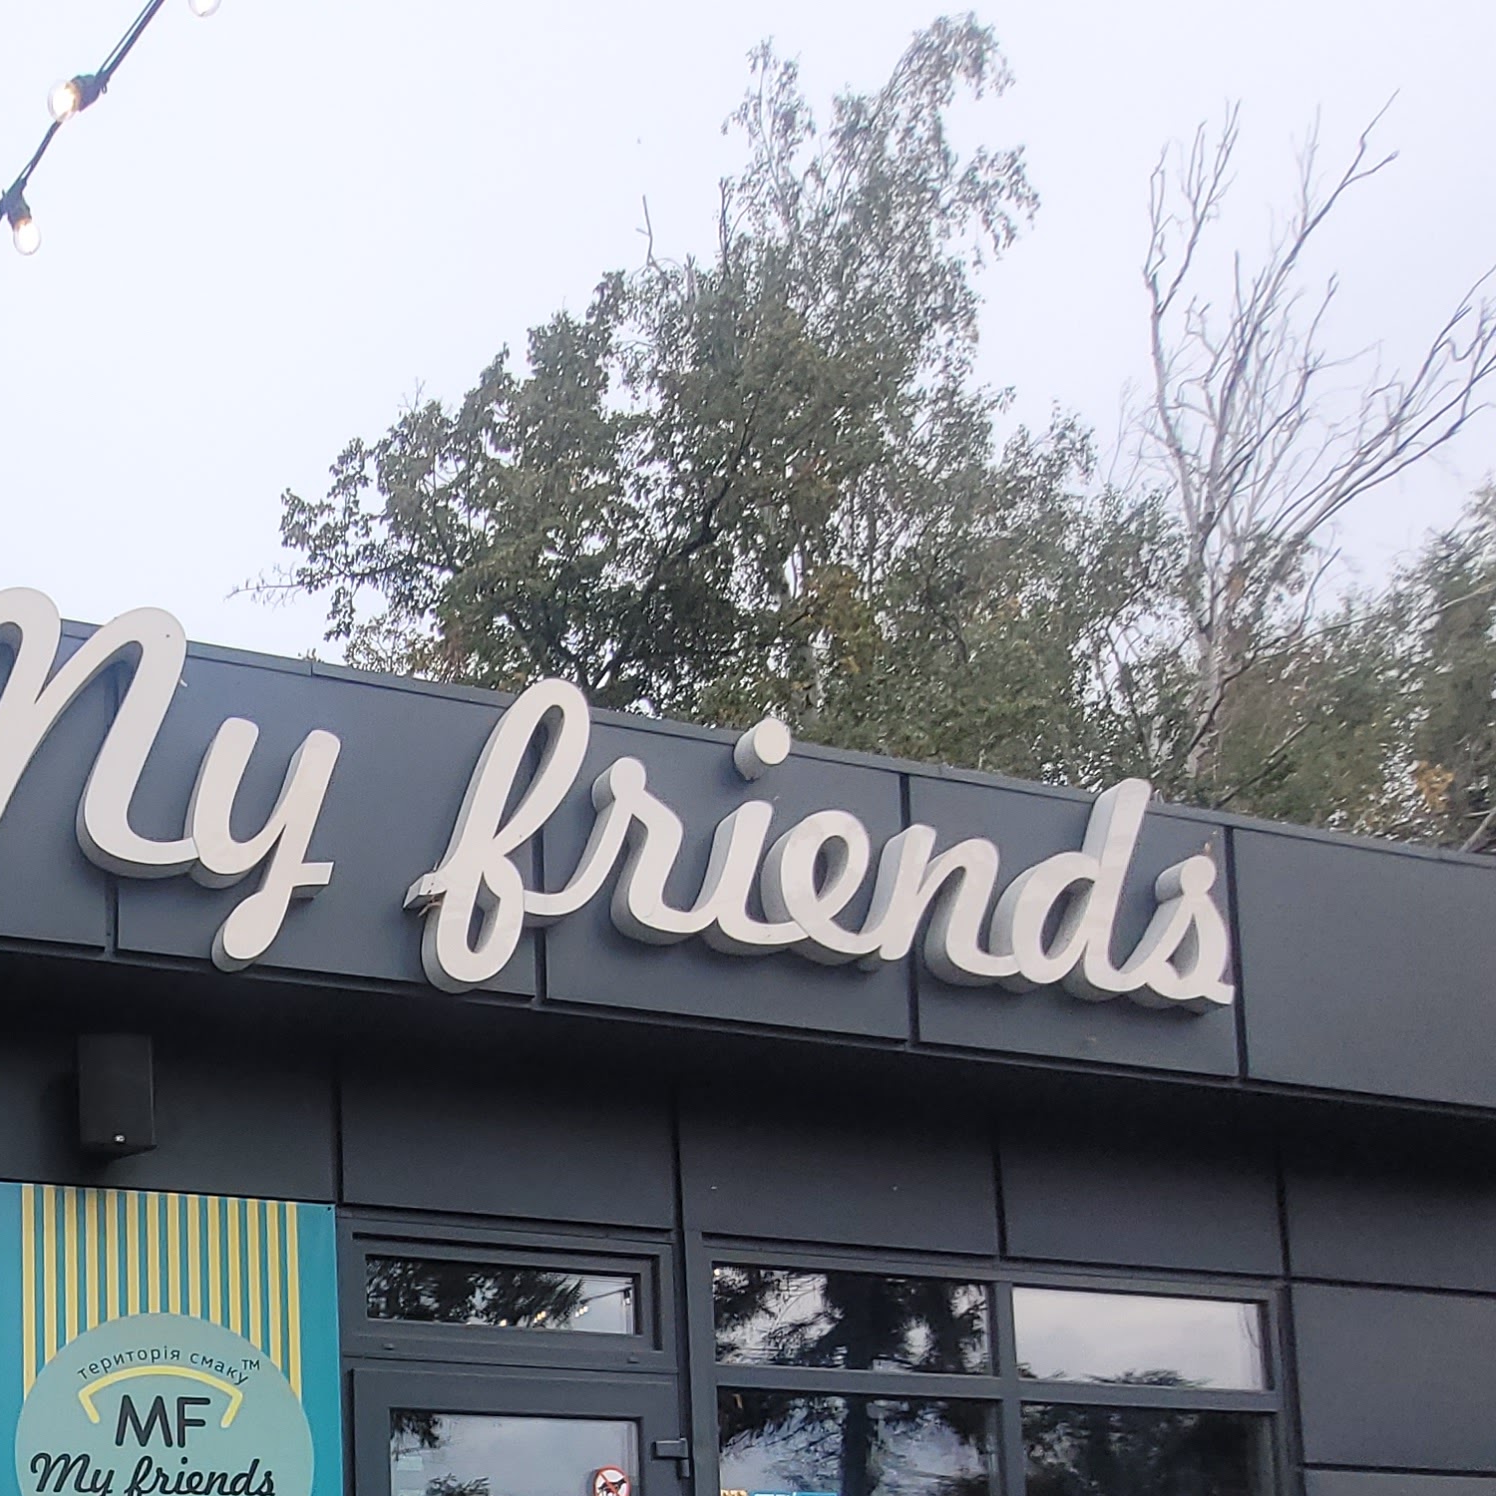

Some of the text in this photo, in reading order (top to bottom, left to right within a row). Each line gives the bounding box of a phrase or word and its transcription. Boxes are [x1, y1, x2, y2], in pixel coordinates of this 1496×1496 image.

[403, 676, 1236, 1010] friends
[77, 1345, 249, 1386] територія смаку
[114, 1394, 211, 1448] MF
